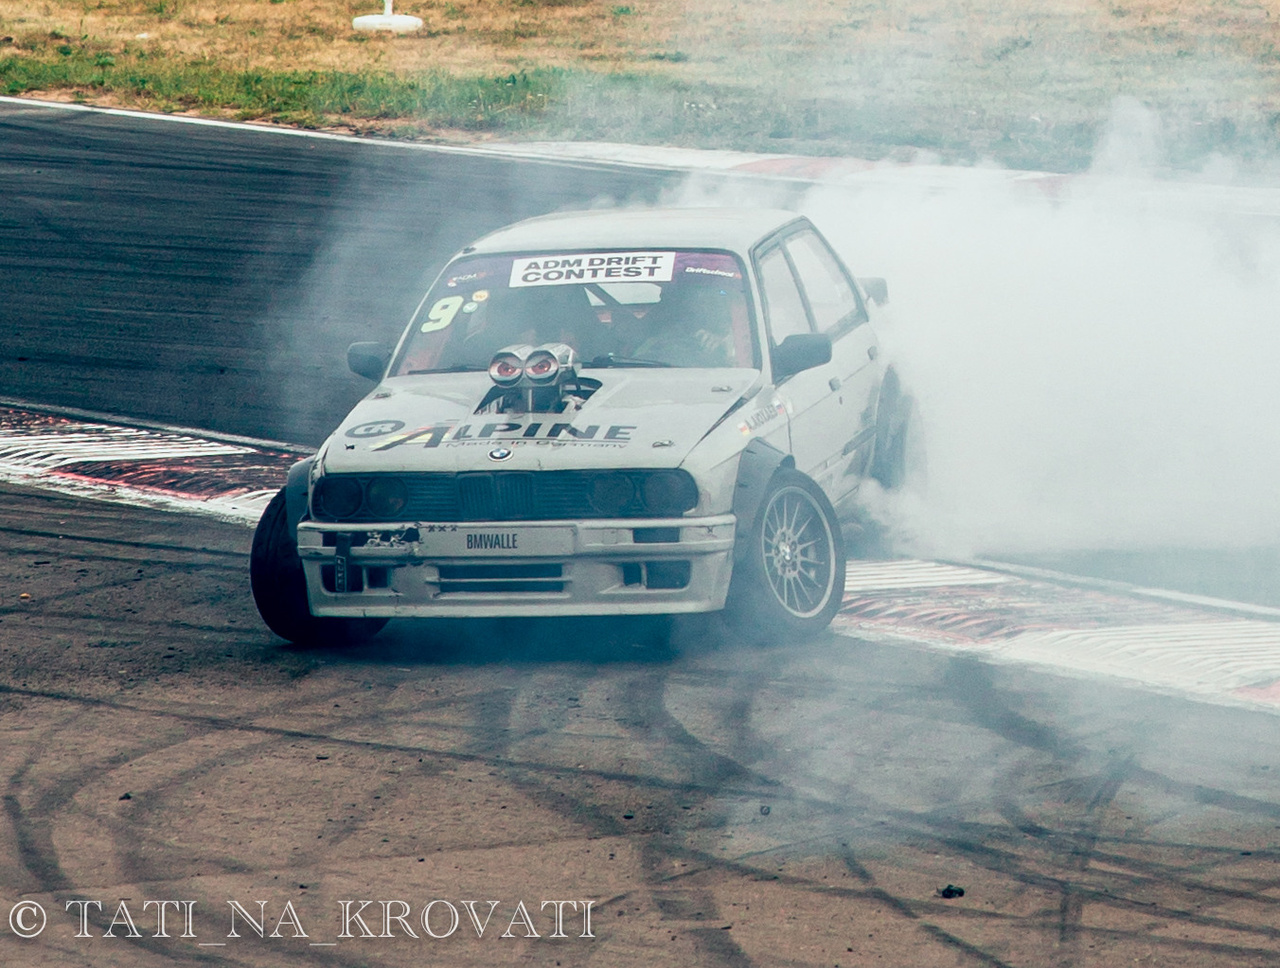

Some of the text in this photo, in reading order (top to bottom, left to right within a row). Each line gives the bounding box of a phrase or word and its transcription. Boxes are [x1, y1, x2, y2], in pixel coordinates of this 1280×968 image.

[523, 256, 663, 271] ADM DRIFT
[521, 266, 661, 283] CONTEST
[420, 295, 464, 333] 9
[372, 421, 637, 452] ALPINE
[466, 533, 518, 550] BMWALLE
